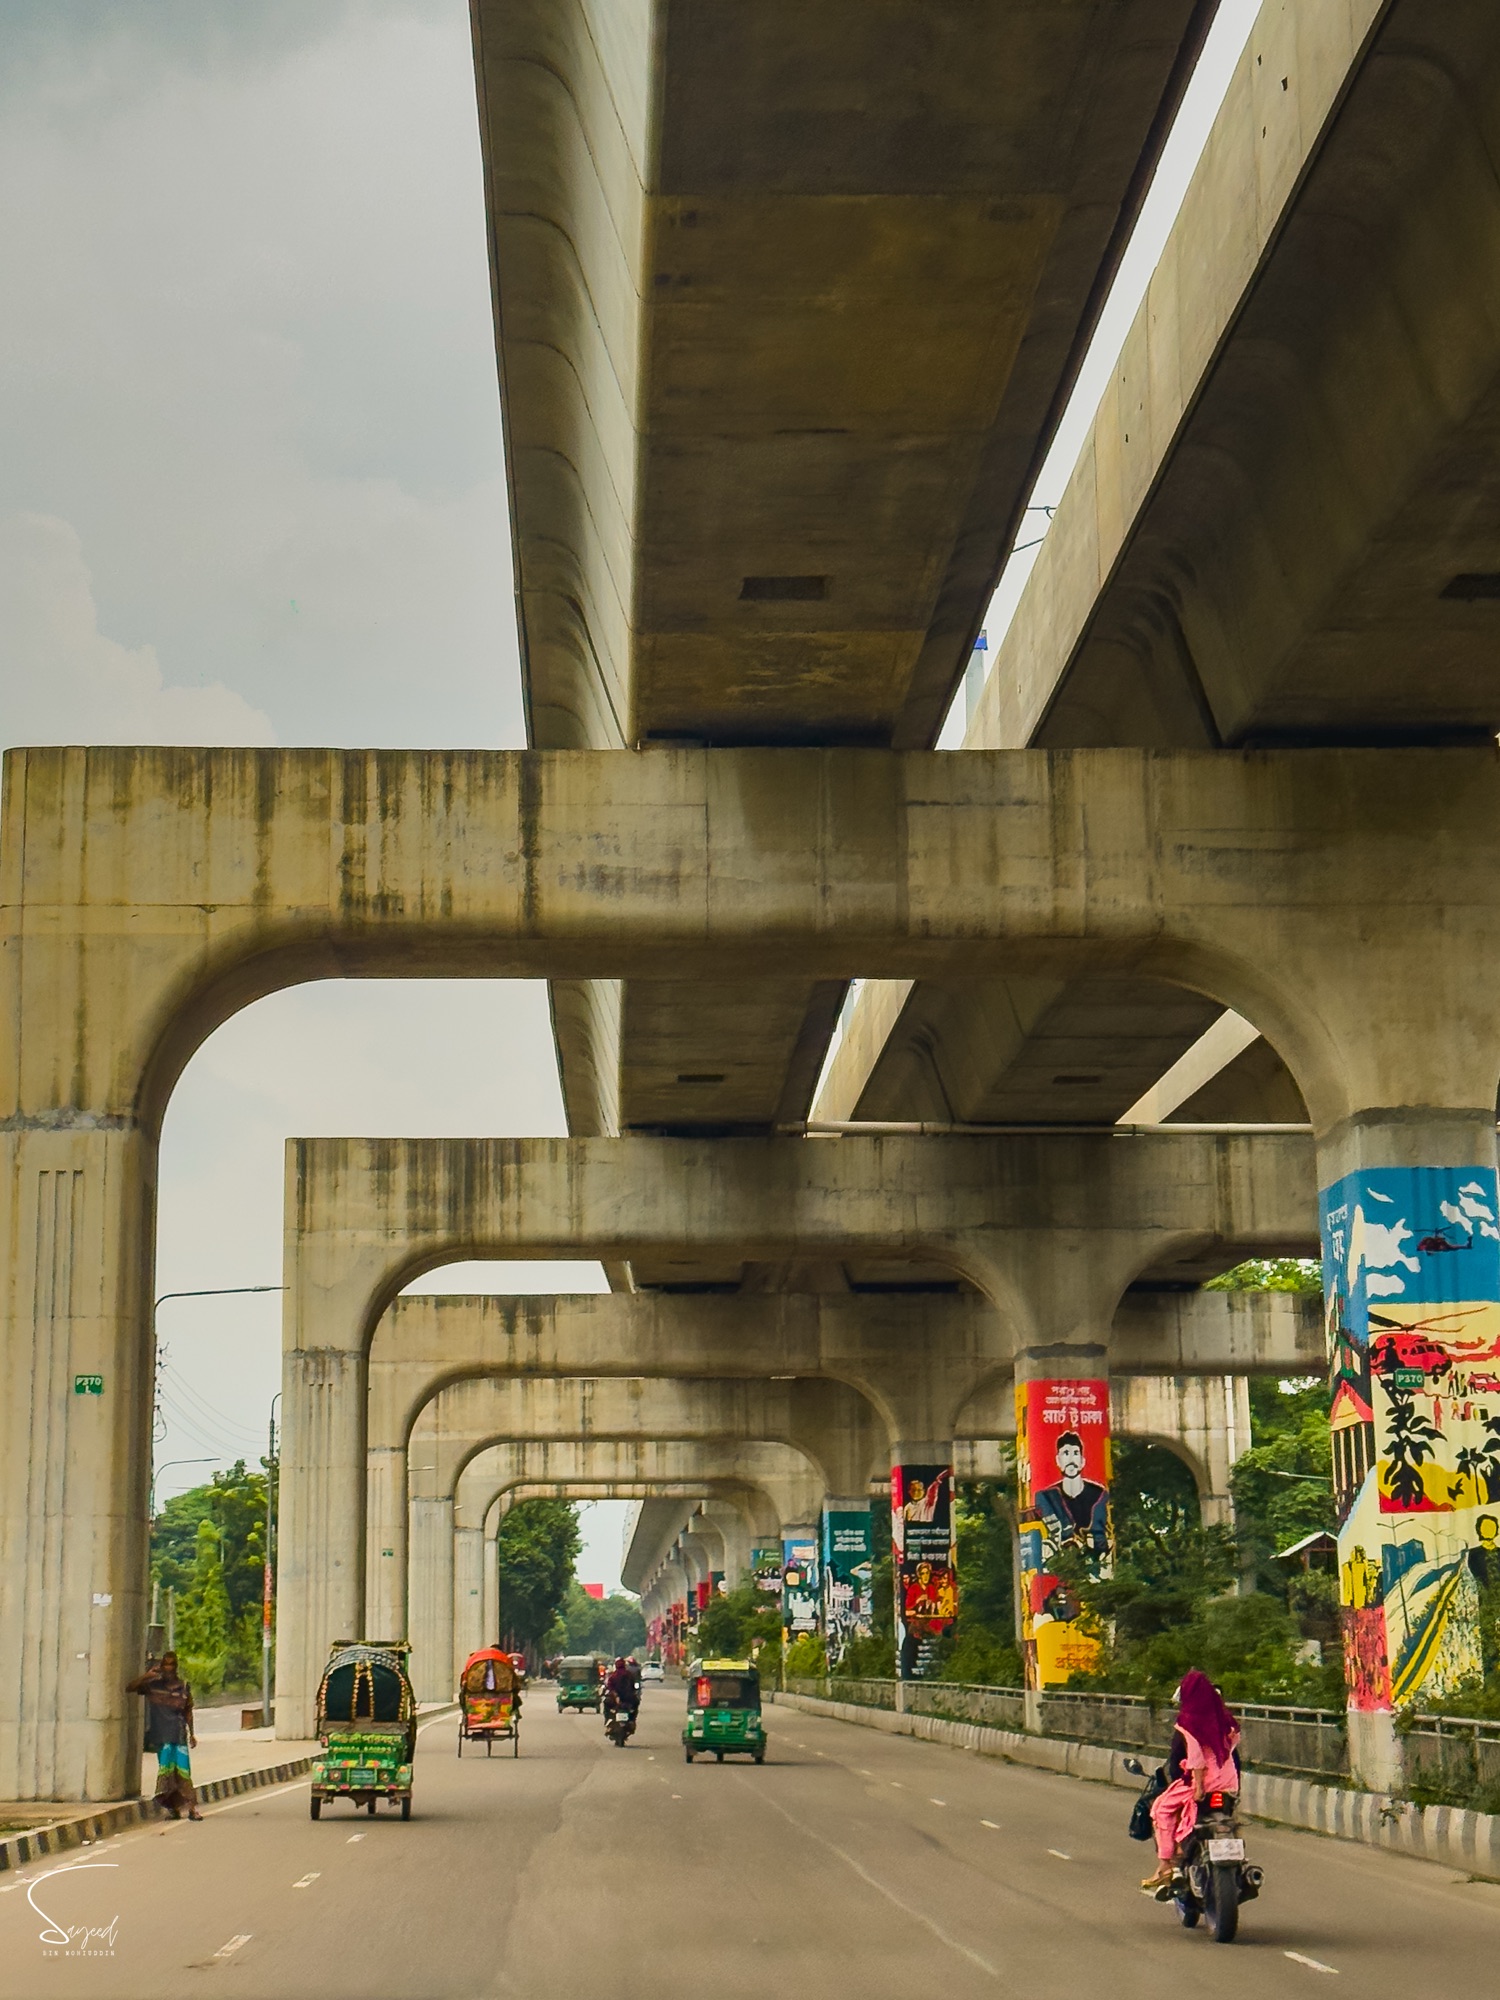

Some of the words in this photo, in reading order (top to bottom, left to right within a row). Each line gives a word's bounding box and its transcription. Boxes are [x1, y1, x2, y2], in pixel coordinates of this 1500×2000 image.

[76, 1377, 101, 1385] P370
[1397, 1374, 1423, 1383] P370
[86, 1385, 91, 1393] L
[1042, 1406, 1066, 1423] মার্চ
[1068, 1407, 1078, 1427] টু
[1080, 1411, 1102, 1424] ঢাকা
